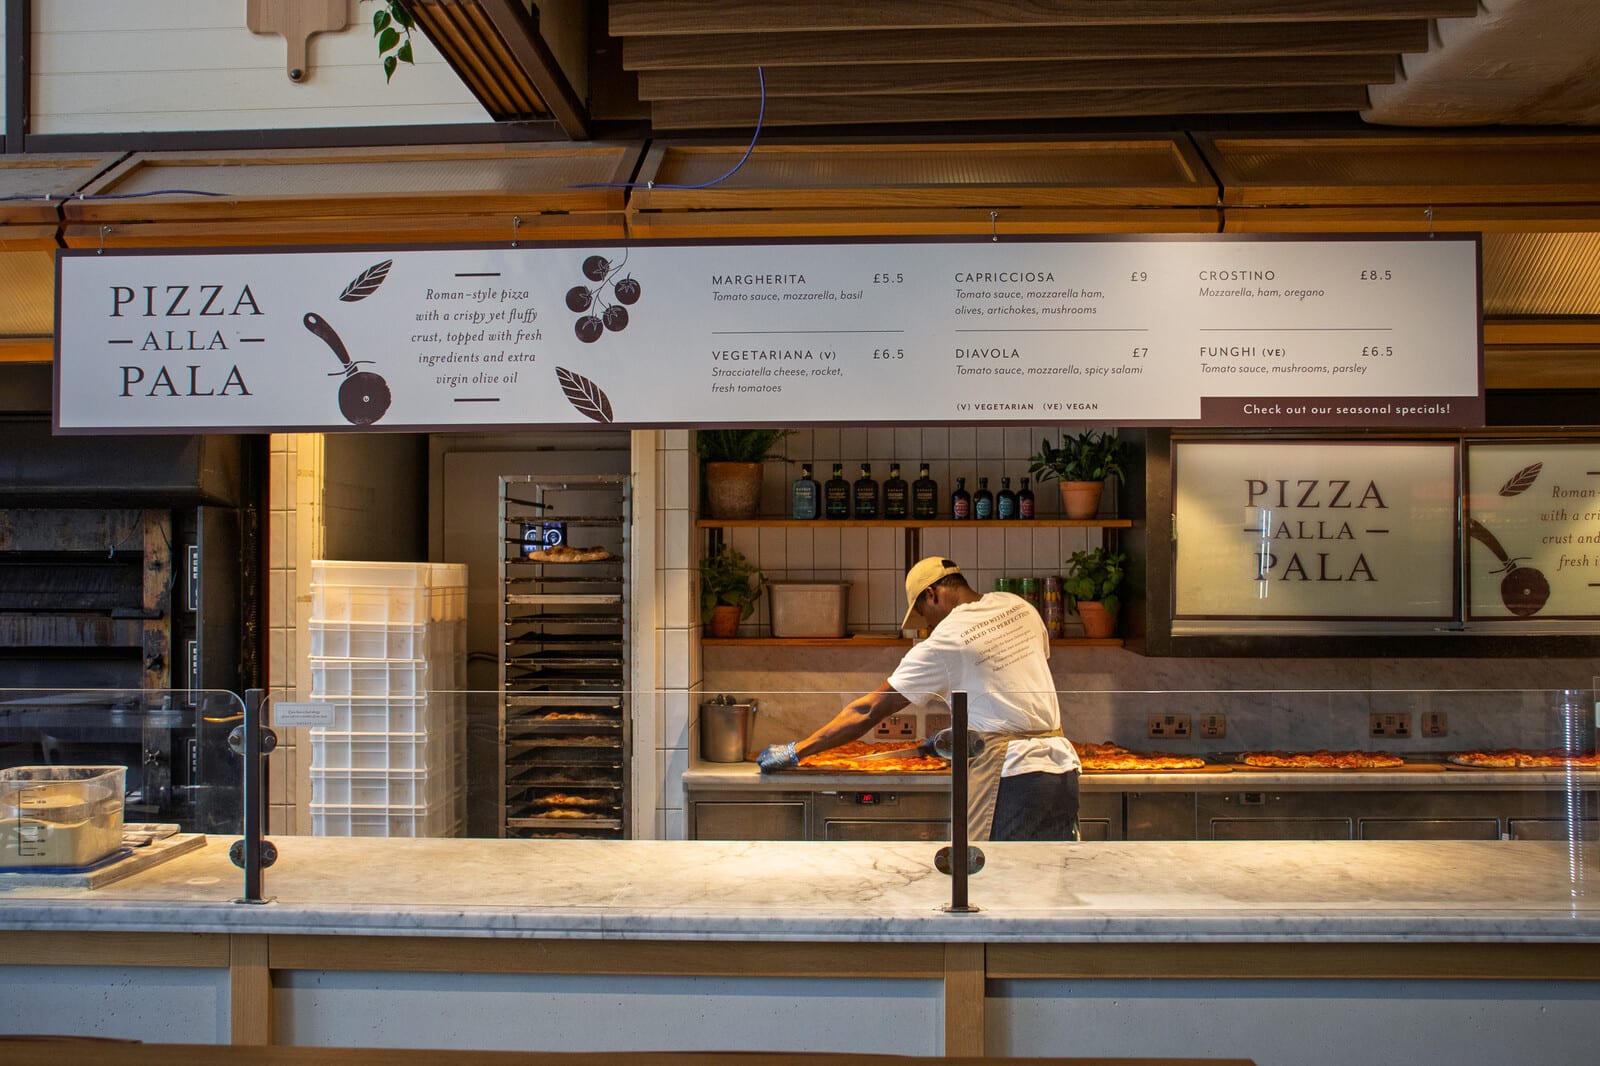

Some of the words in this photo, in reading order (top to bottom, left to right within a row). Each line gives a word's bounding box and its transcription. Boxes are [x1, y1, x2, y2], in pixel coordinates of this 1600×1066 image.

[713, 275, 806, 284] MARGHERITA
[874, 274, 903, 283] £5.5
[955, 273, 1054, 282] CAPRICCIOSA
[1131, 272, 1147, 281] £9
[1199, 271, 1274, 280] CROSTINO
[1361, 271, 1391, 280] £8.5
[426, 288, 497, 303] Roman-style
[501, 289, 528, 302] pizza
[713, 292, 747, 301] Tomato
[783, 291, 837, 300] mozzarella,
[840, 290, 863, 299] basil
[956, 289, 991, 298] Tomato
[1027, 289, 1078, 298] mozzarella
[1081, 289, 1104, 298] ham,
[1199, 288, 1254, 297] Mozzarella,
[1258, 288, 1281, 297] ham,
[1285, 290, 1324, 300] oregano
[110, 285, 264, 317] PIZZA
[416, 310, 438, 321] with
[442, 313, 451, 321] a
[454, 311, 485, 324] crispy
[485, 311, 504, 324] yet
[507, 308, 538, 323] fluffy
[955, 306, 984, 315] olives,
[987, 305, 1038, 315] artichokes,
[1042, 305, 1096, 314] mushrooms
[141, 331, 229, 350] ALLA
[412, 333, 441, 343] crust,
[447, 330, 483, 345] topped
[489, 330, 511, 341] with
[514, 329, 541, 344] fresh
[712, 350, 813, 360] VEGETARIANA
[820, 352, 835, 360] (V)
[874, 349, 903, 359] £6.5
[956, 349, 1019, 358] DIAVOLA
[1133, 348, 1148, 357] £7
[1201, 347, 1255, 356] FUNGHI
[1263, 349, 1285, 357] (VE)
[1362, 347, 1392, 356] £6.5
[419, 352, 479, 367] ingredients
[483, 351, 504, 362] and
[508, 352, 535, 361] extra
[712, 367, 771, 376] Stracciatella
[774, 367, 808, 376] cheese,
[812, 366, 842, 376] rocket,
[957, 365, 991, 375] Tomato
[1028, 365, 1081, 374] mozzarella,
[1085, 366, 1109, 376] spicy
[1112, 365, 1142, 374] salami
[1201, 363, 1236, 373] Tomato
[1272, 364, 1329, 373] mushrooms,
[1332, 363, 1367, 375] parsley
[120, 365, 253, 396] PALA
[437, 374, 467, 388] virgin
[473, 372, 498, 383] olive
[503, 372, 517, 383] oil
[712, 383, 734, 392] fresh
[1244, 404, 1281, 414] Check
[1287, 405, 1307, 415] out
[1312, 407, 1332, 415] our
[1337, 404, 1390, 414] seasonal
[1396, 404, 1449, 416] specials!
[1245, 480, 1388, 508] PIZZA
[1541, 509, 1567, 521] with
[1572, 512, 1579, 521] a
[1274, 521, 1355, 539] ALLA
[1542, 534, 1572, 544] crust
[1254, 553, 1378, 581] PALA
[1556, 554, 1589, 571] fresh
[960, 620, 989, 638] CRAFTED
[988, 612, 1007, 625] WITH
[964, 630, 987, 645] BAKED
[986, 625, 997, 633] TO
